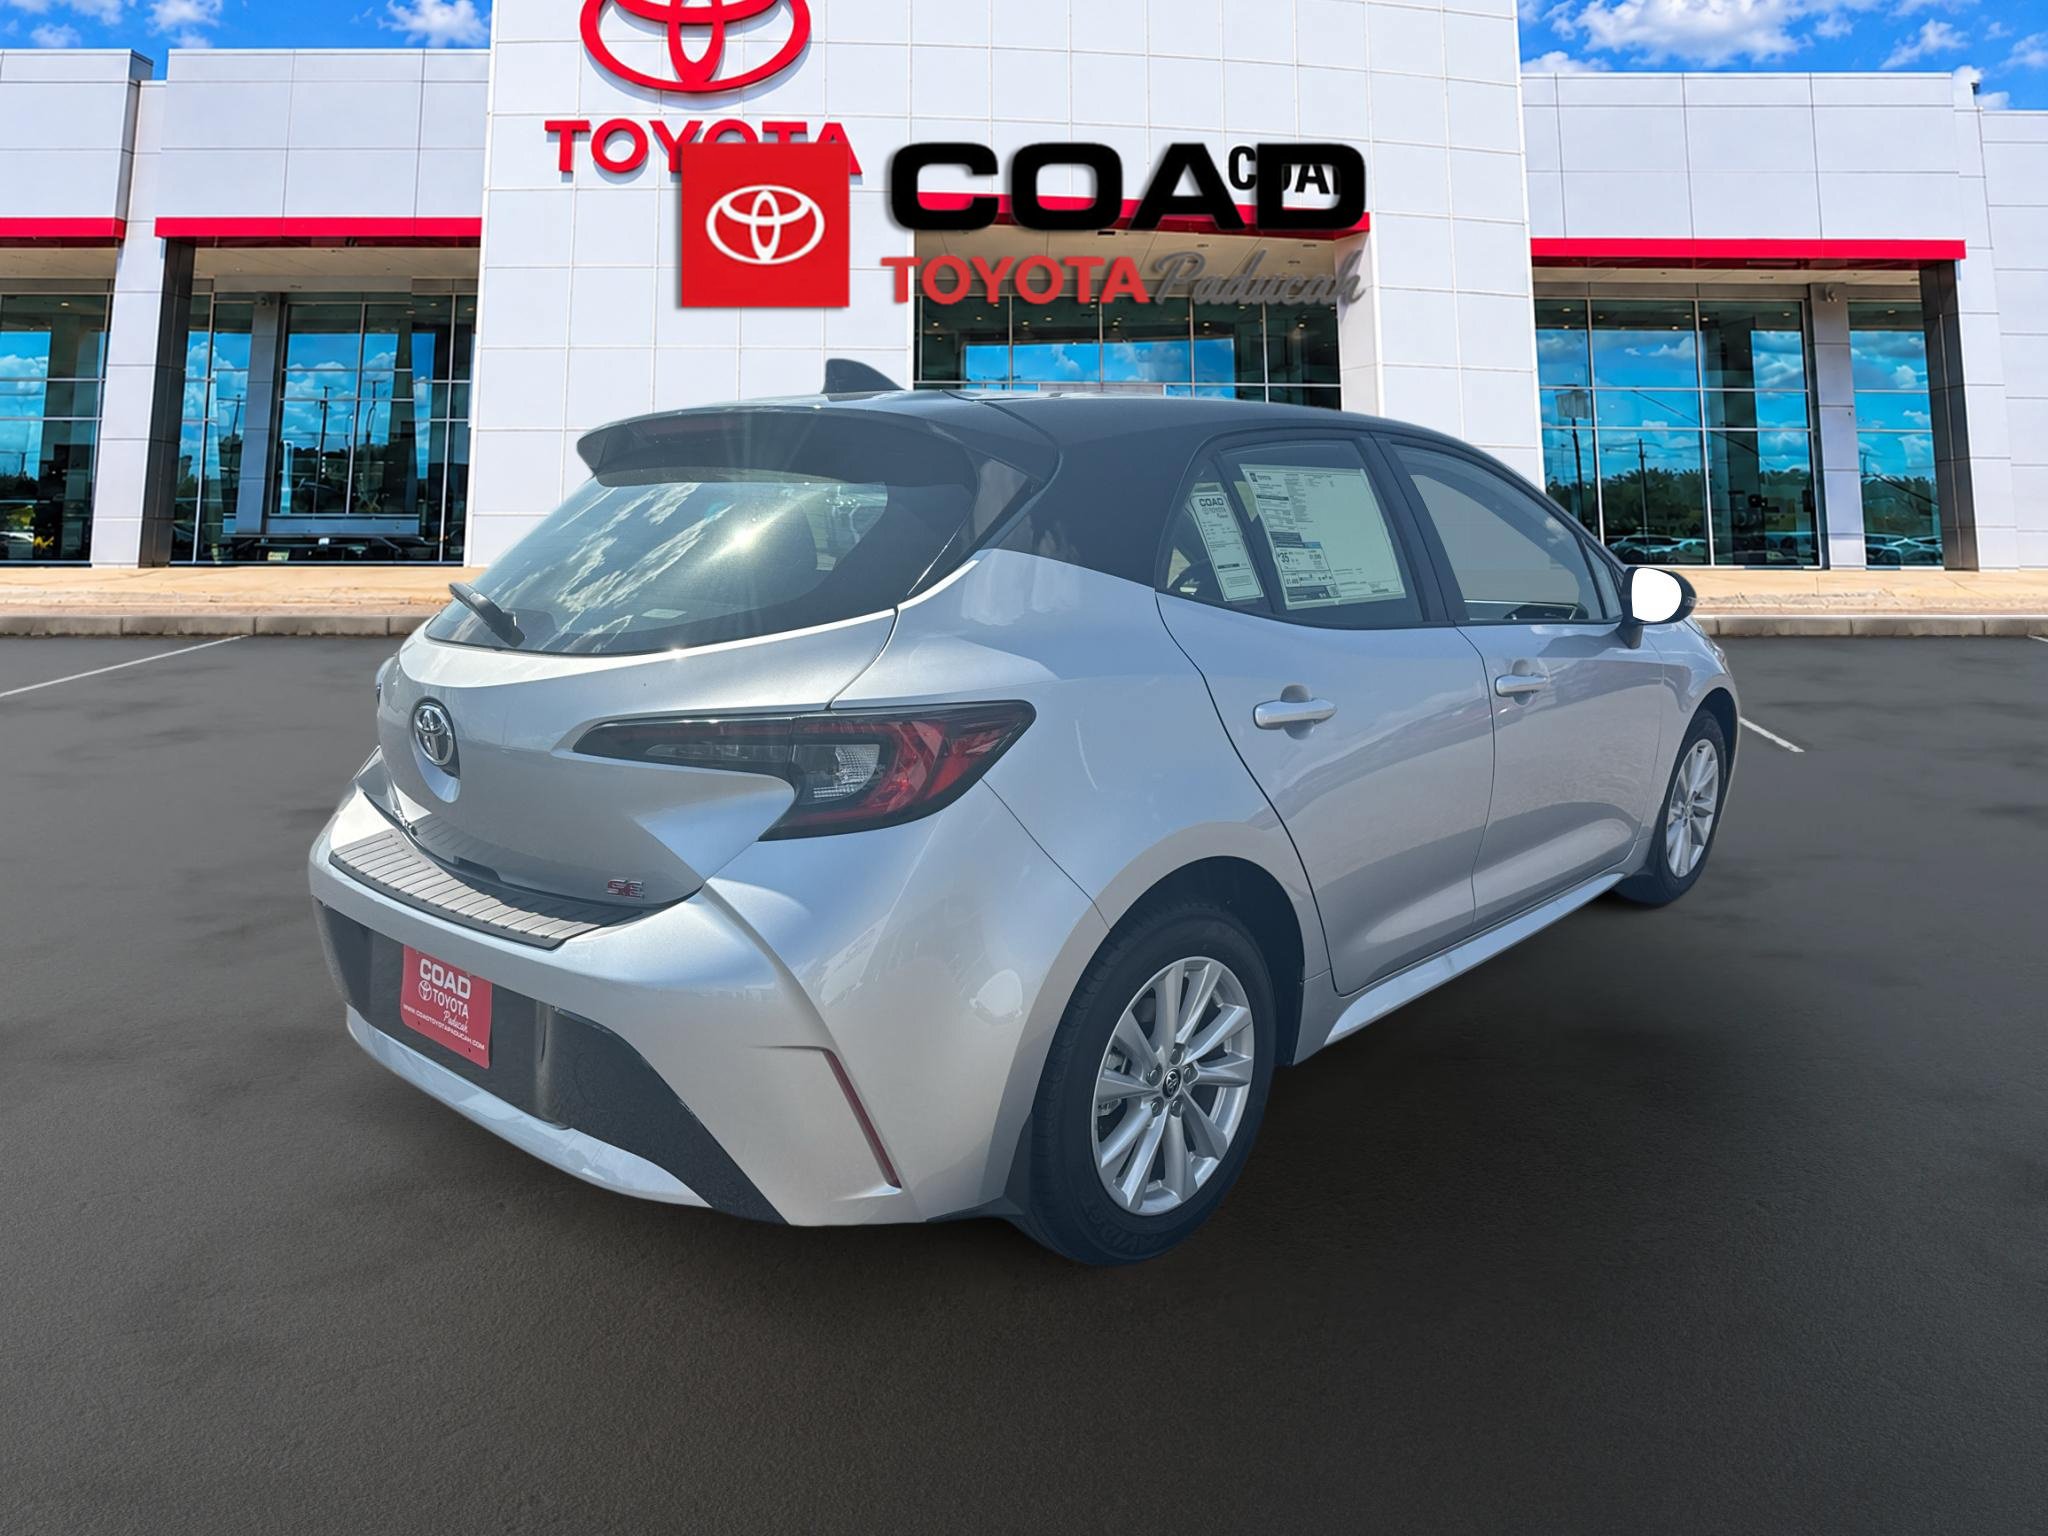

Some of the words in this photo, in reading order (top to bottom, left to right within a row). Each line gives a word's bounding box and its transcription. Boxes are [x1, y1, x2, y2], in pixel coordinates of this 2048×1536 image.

[1228, 145, 1341, 195] CA
[1199, 497, 1225, 507] COAD
[608, 879, 642, 897] SE
[420, 958, 471, 1000] COAD
[433, 988, 469, 1019] TOYOTA
[443, 1010, 469, 1033] Paducah
